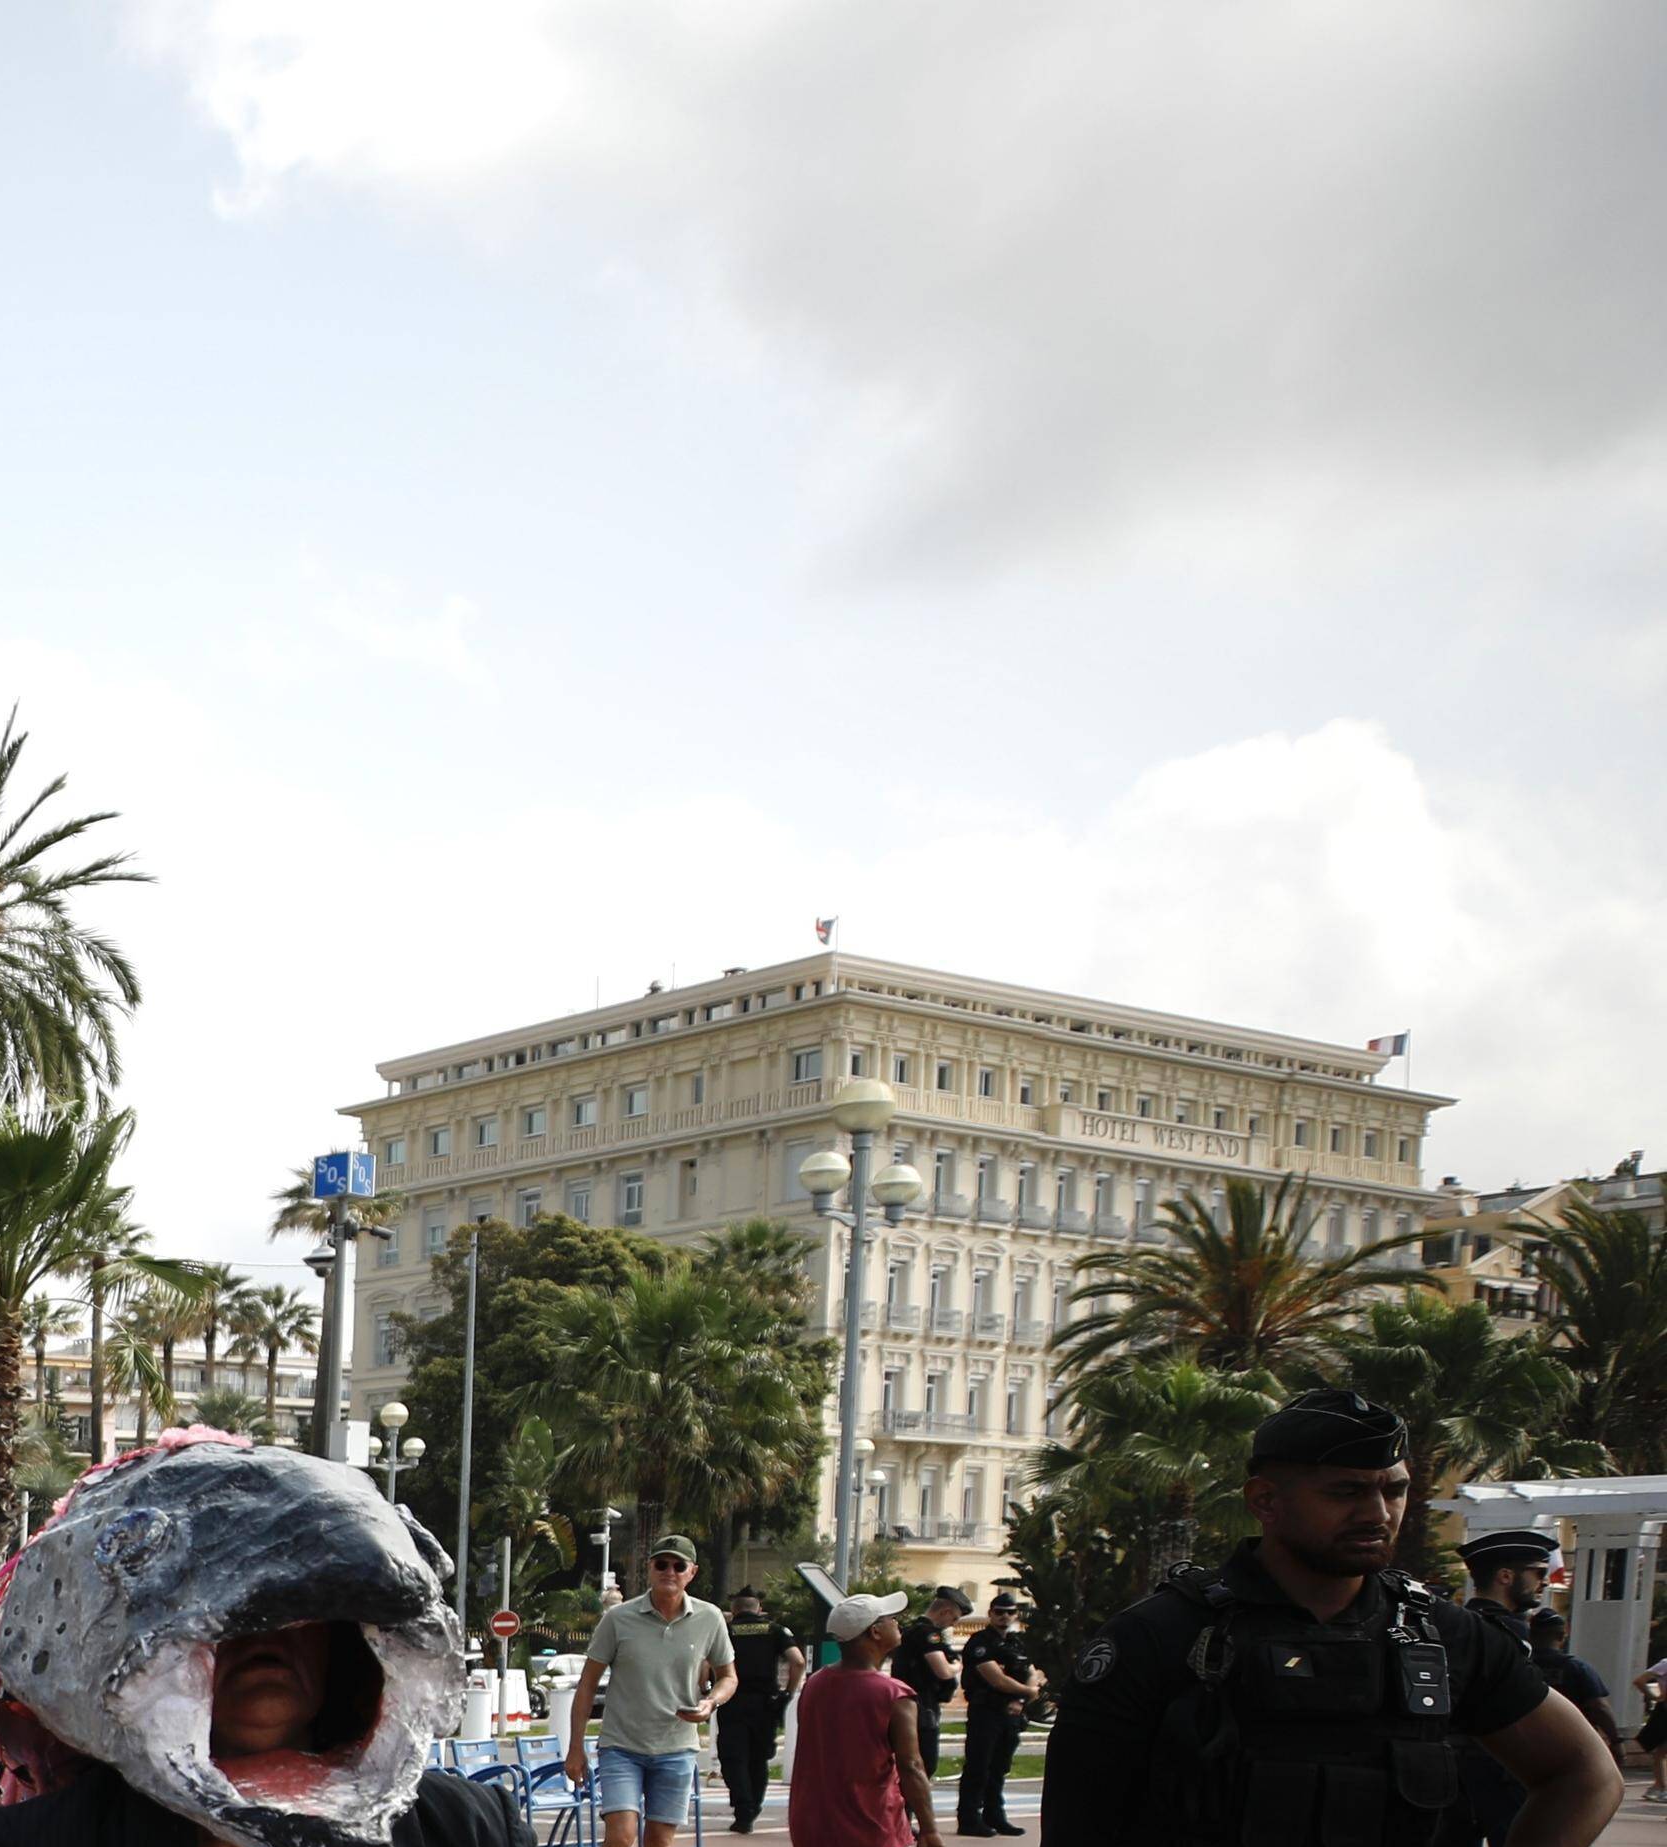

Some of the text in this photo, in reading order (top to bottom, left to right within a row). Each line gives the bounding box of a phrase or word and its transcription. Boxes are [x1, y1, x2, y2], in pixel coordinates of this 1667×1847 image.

[1080, 1114, 1140, 1144] HOTEL
[317, 1157, 347, 1193] SOS
[353, 1153, 372, 1195] SOS
